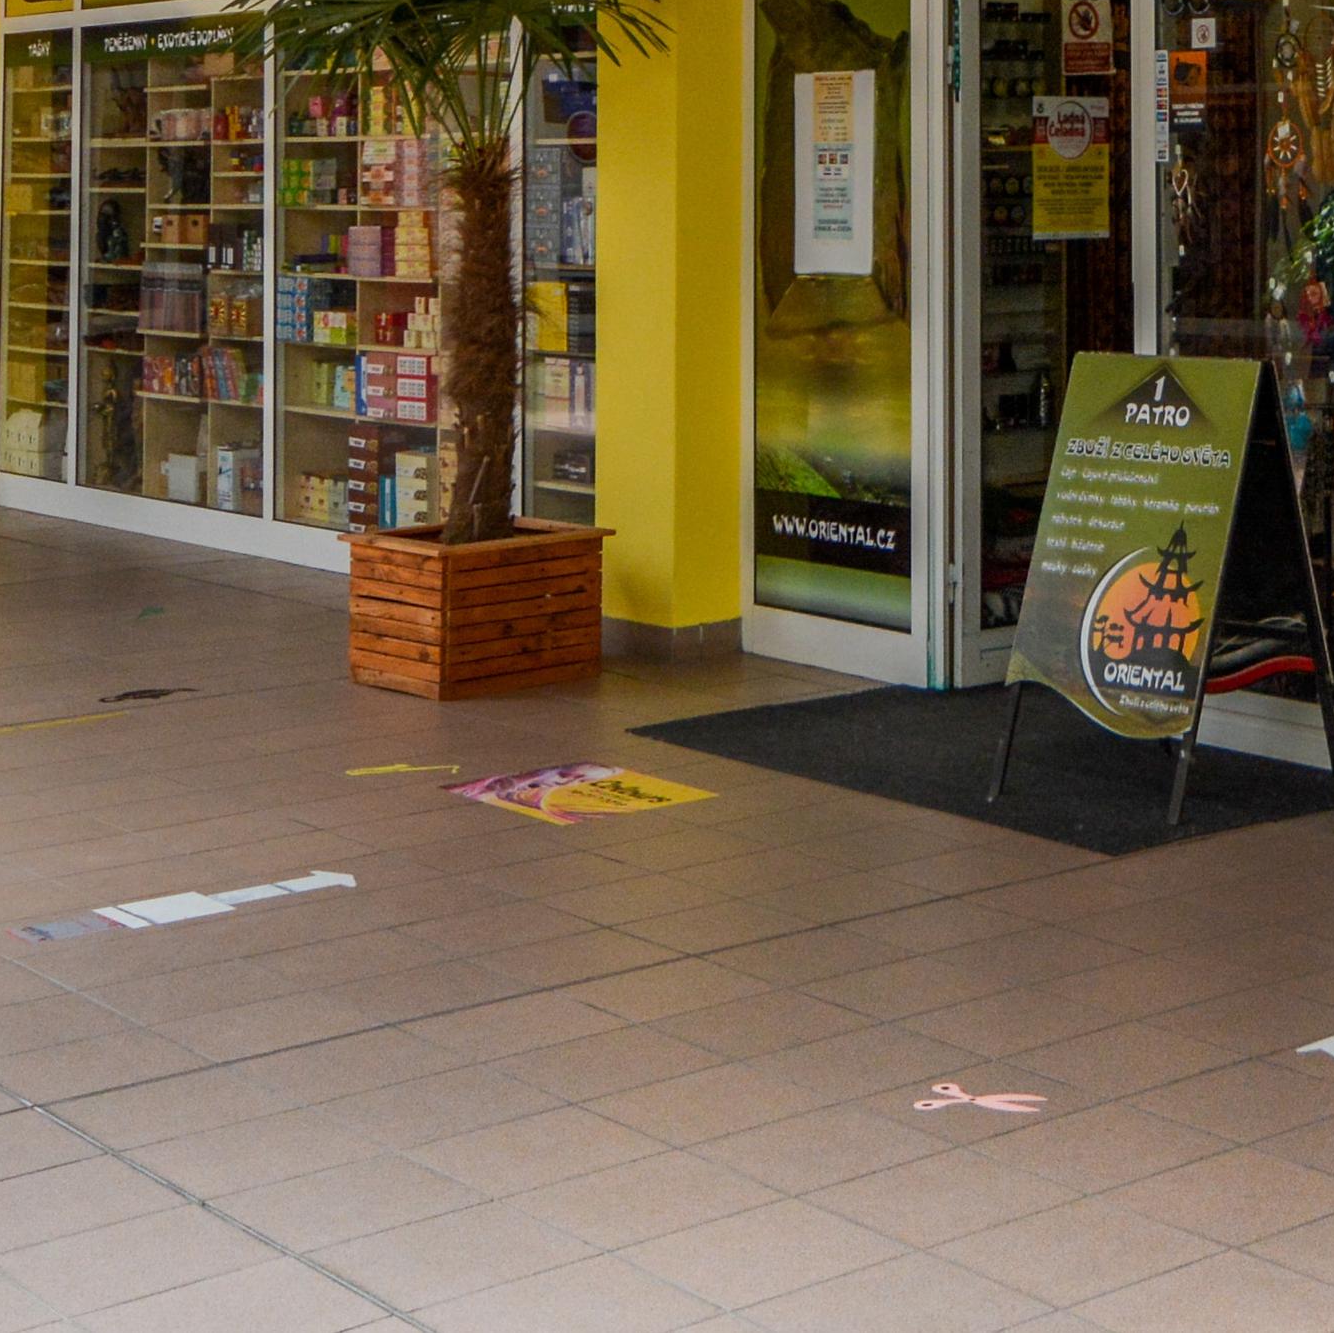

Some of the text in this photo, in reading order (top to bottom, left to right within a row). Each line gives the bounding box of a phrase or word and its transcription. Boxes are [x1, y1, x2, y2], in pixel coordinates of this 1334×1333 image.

[1153, 375, 1166, 401] 1
[1125, 402, 1190, 428] PATRO
[773, 515, 896, 550] WWW.ORIENTAL.CZ
[1104, 662, 1185, 691] ORIENTAL
